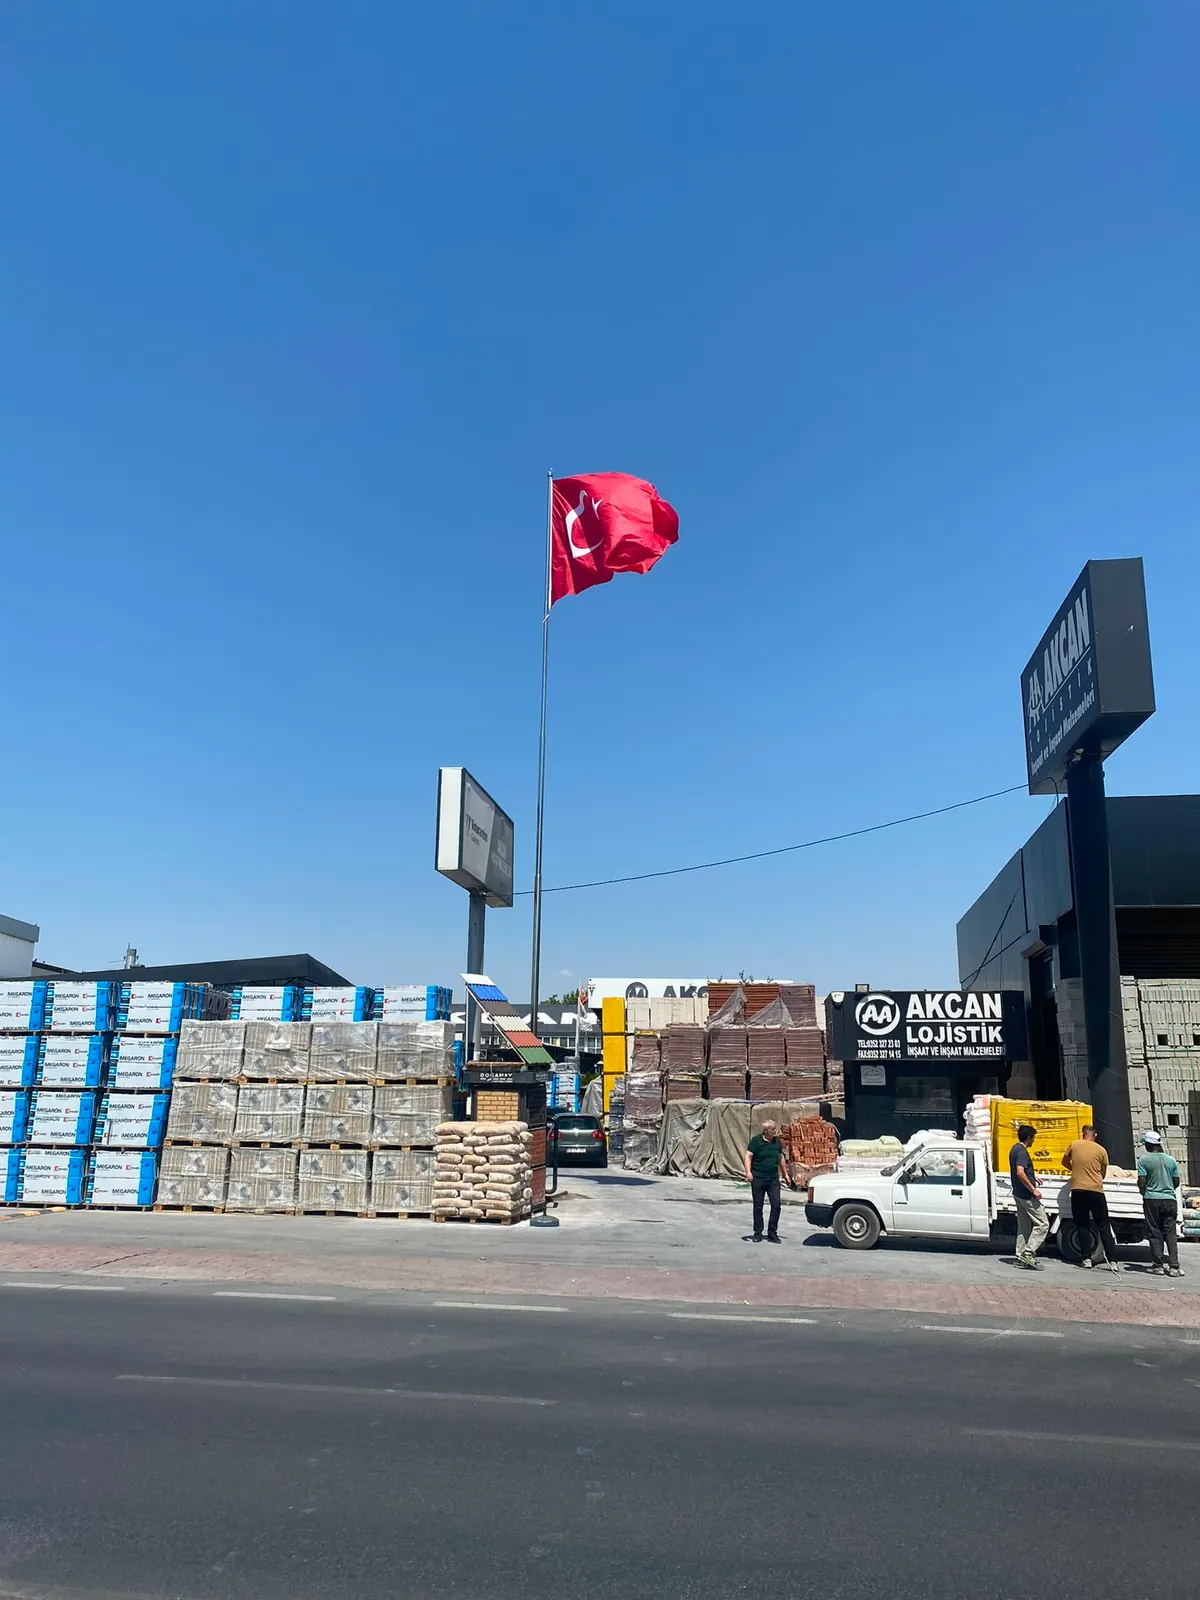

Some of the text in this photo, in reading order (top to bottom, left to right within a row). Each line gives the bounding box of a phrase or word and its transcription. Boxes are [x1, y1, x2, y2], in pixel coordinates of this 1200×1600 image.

[1044, 588, 1090, 706] AKCAN
[1062, 681, 1095, 737] Malzemeleri
[906, 993, 1002, 1018] AKCAN
[906, 1022, 1004, 1043] LOJİSTİK
[879, 1039, 887, 1048] 327
[887, 1039, 894, 1048] 23
[879, 1049, 887, 1059] 327
[888, 1049, 895, 1059] 14
[895, 1049, 901, 1059] 15
[907, 1045, 929, 1058] İNŞAAT
[930, 1046, 939, 1056] VE
[940, 1045, 962, 1058] İNŞAAT
